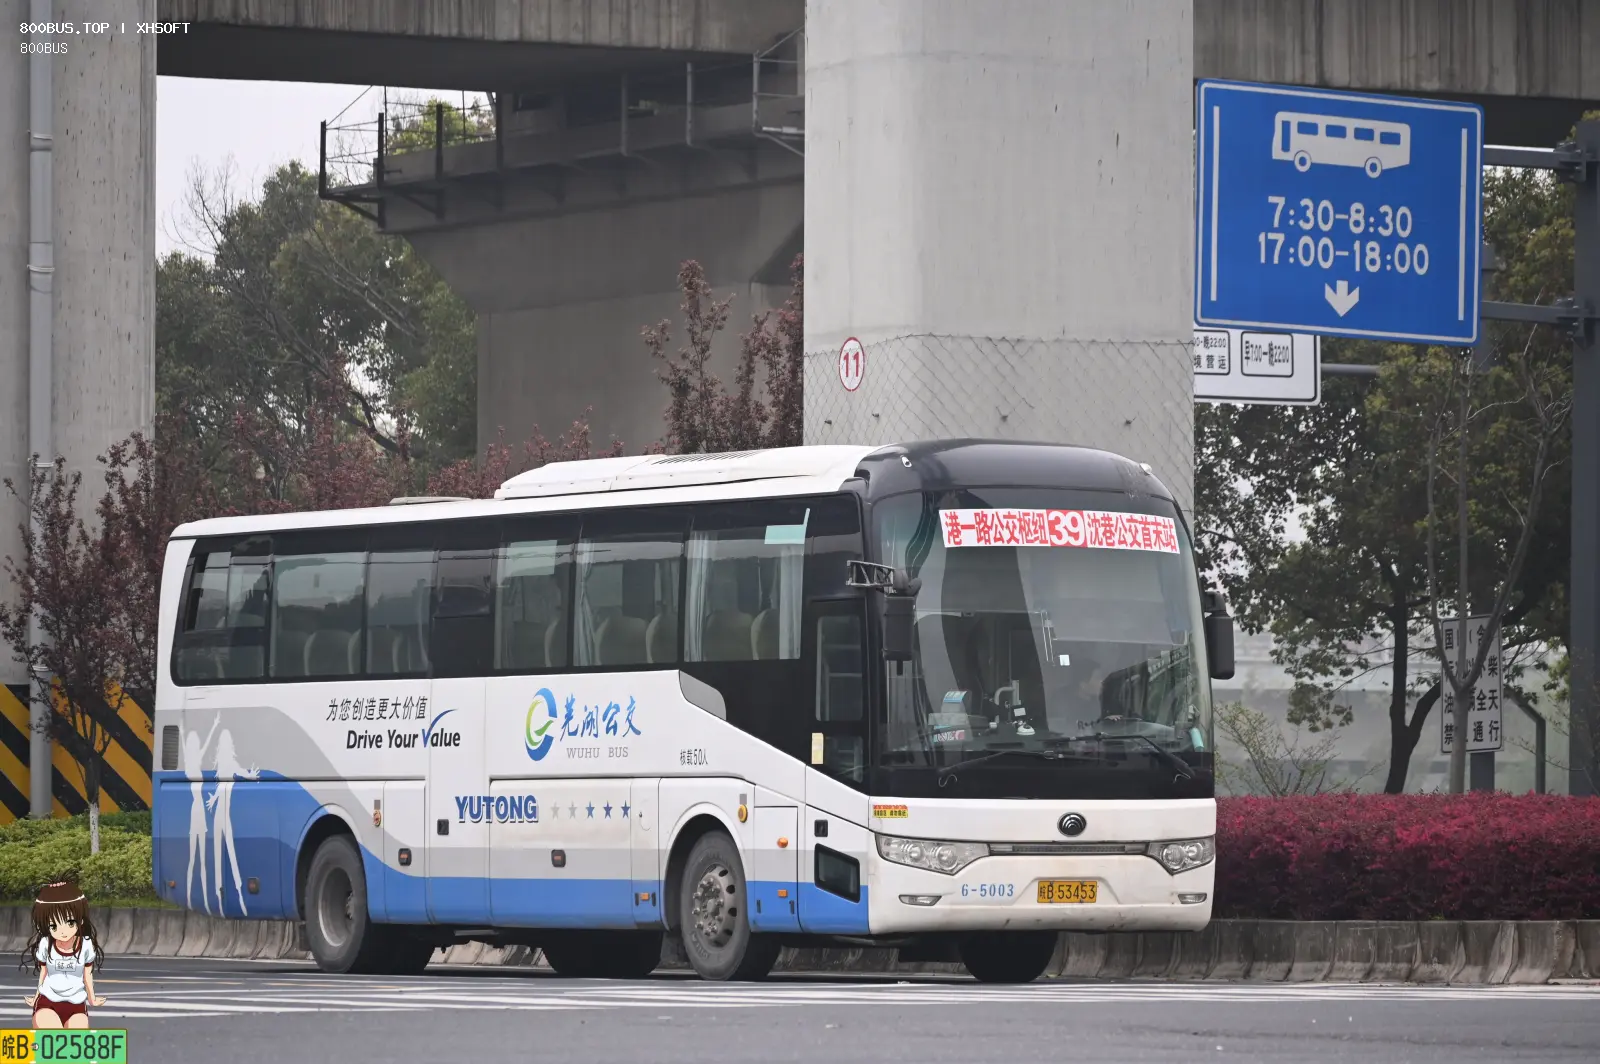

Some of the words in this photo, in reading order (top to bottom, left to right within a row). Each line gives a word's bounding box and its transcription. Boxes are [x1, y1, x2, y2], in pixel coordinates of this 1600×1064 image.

[1267, 195, 1413, 238] 7:30-8:30
[1258, 231, 1430, 275] 17:00-18:00
[843, 351, 860, 378] 11
[944, 510, 1049, 546] 港一路公交枢纽
[1048, 511, 1085, 546] 39
[1087, 512, 1177, 552] 沈巷公交首末站
[326, 696, 428, 722] 为您创造更大价值
[560, 693, 642, 742] 芜湖公交
[346, 729, 383, 750] Drive
[387, 728, 419, 749] Your
[421, 709, 461, 748] Value
[566, 747, 600, 759] WUHU
[608, 747, 629, 758] BUS
[679, 748, 709, 766] 核载50人
[454, 795, 540, 824] YUTONG
[961, 883, 1014, 898] 6-5003
